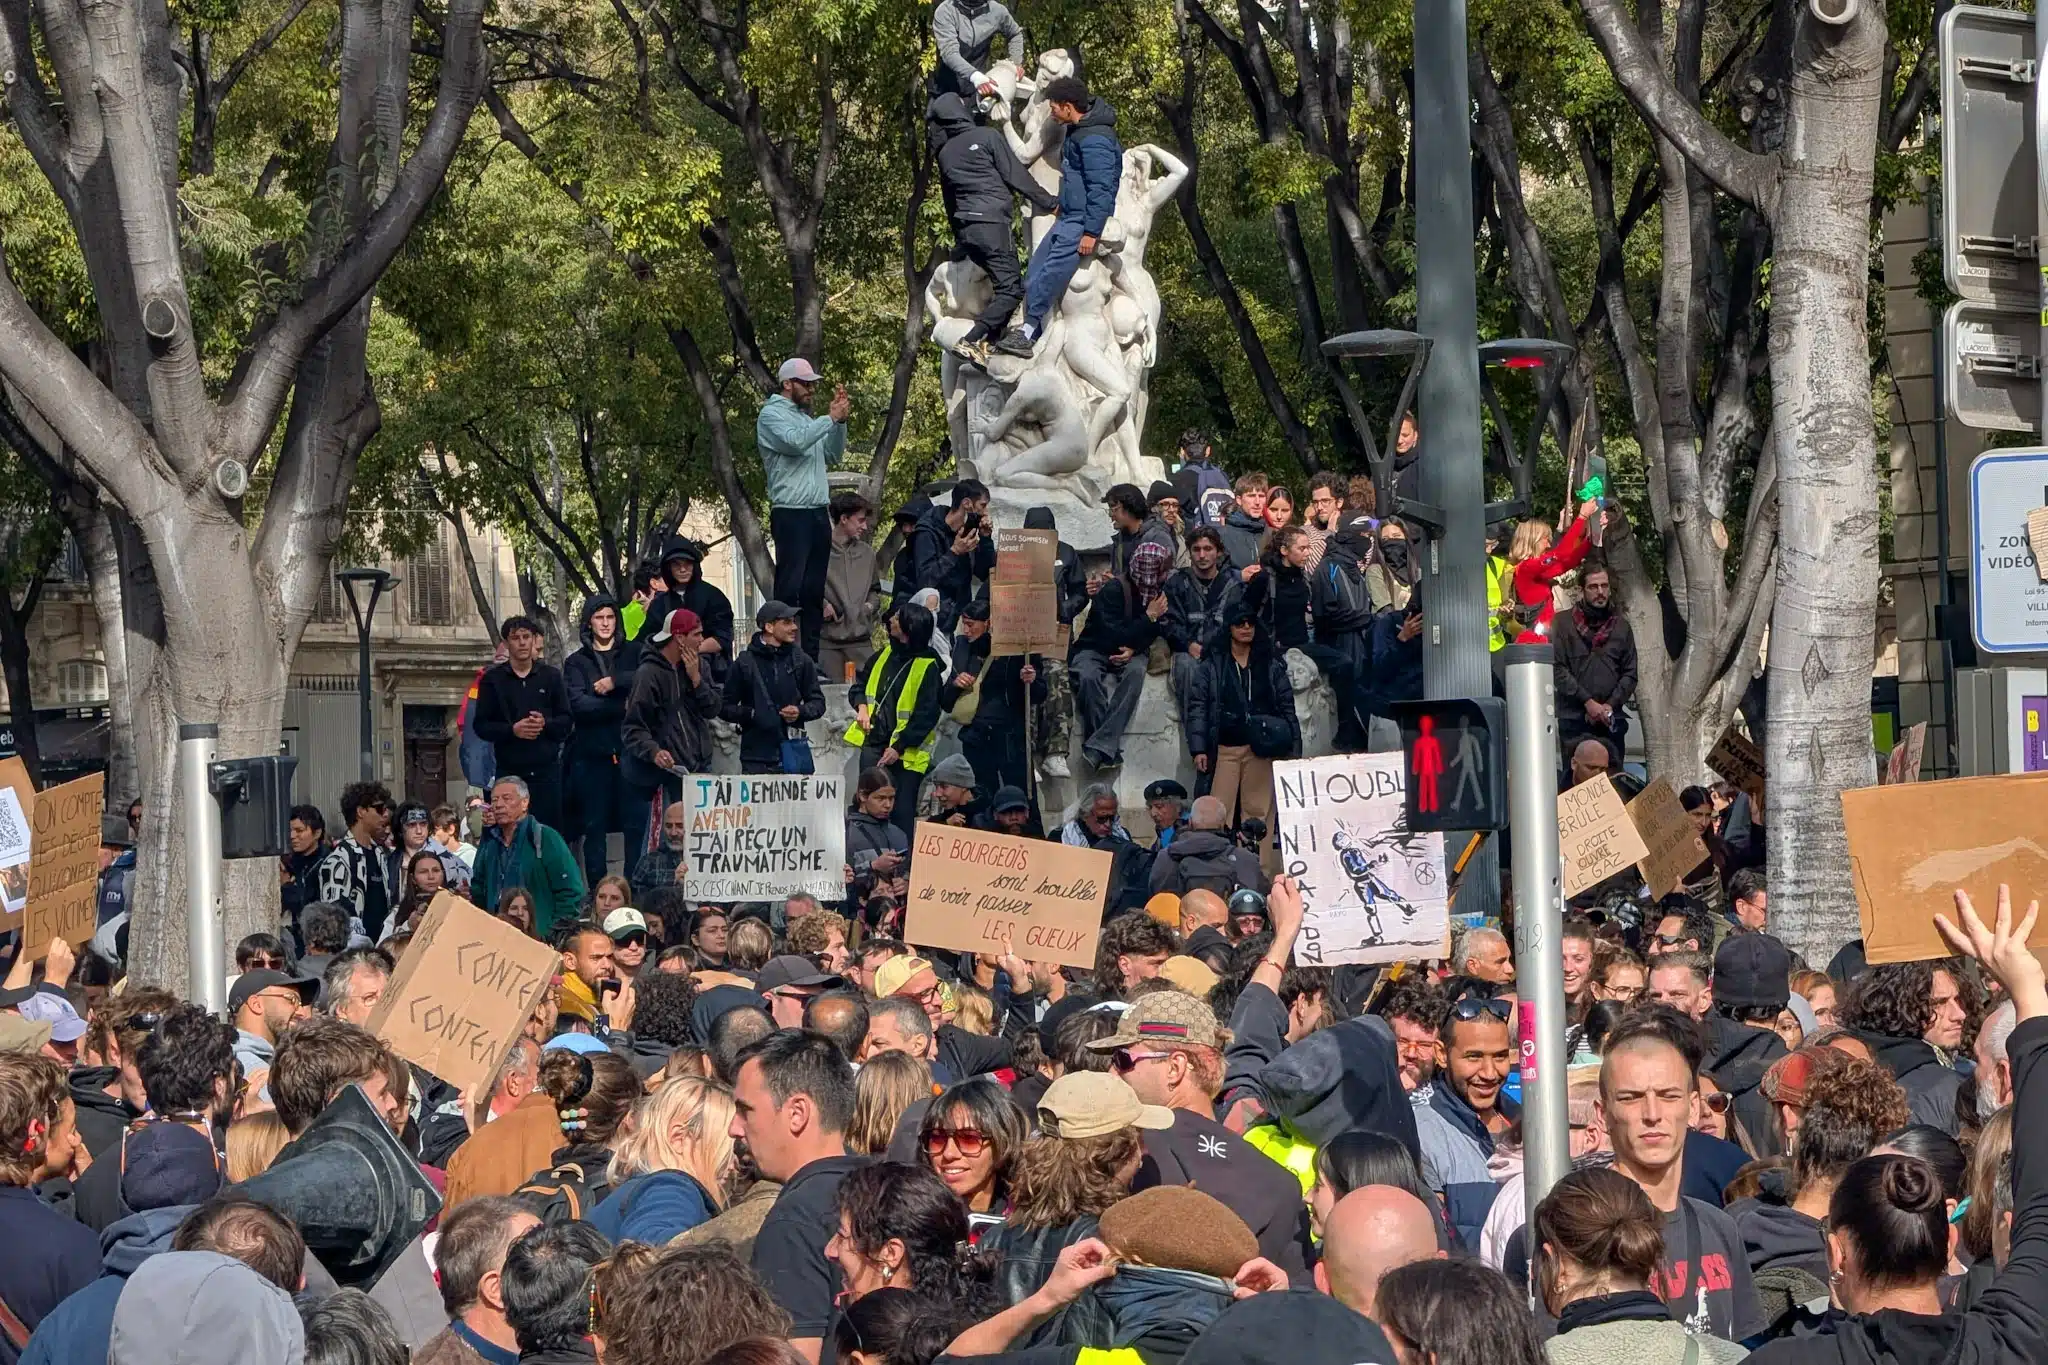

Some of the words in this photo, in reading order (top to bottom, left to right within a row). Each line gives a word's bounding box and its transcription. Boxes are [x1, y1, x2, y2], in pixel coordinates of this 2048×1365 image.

[1000, 533, 1017, 541] NOUS
[740, 777, 809, 804] DEMANDÉ
[815, 780, 836, 799] UN
[1280, 770, 1318, 808] NI
[1564, 777, 1610, 813] MONDE
[33, 798, 57, 835] ON
[61, 791, 103, 822] COMPTE
[692, 804, 752, 832] AVENIR
[782, 826, 807, 848] UN
[918, 834, 943, 857] LES
[1283, 824, 1317, 855] NI
[1576, 824, 1619, 857] DROITE
[32, 839, 56, 868] LES
[1577, 843, 1612, 871] OUVRE
[1570, 872, 1588, 890] LE
[1591, 851, 1625, 878] GAZ
[917, 884, 936, 901] de
[940, 887, 971, 906] voir
[973, 893, 1033, 917] passer
[987, 873, 1030, 893] sont
[1033, 876, 1098, 901] troublés
[26, 908, 50, 948] LES
[982, 919, 1015, 941] LES
[1026, 925, 1086, 952] GUEUX
[1515, 923, 1543, 956] 312
